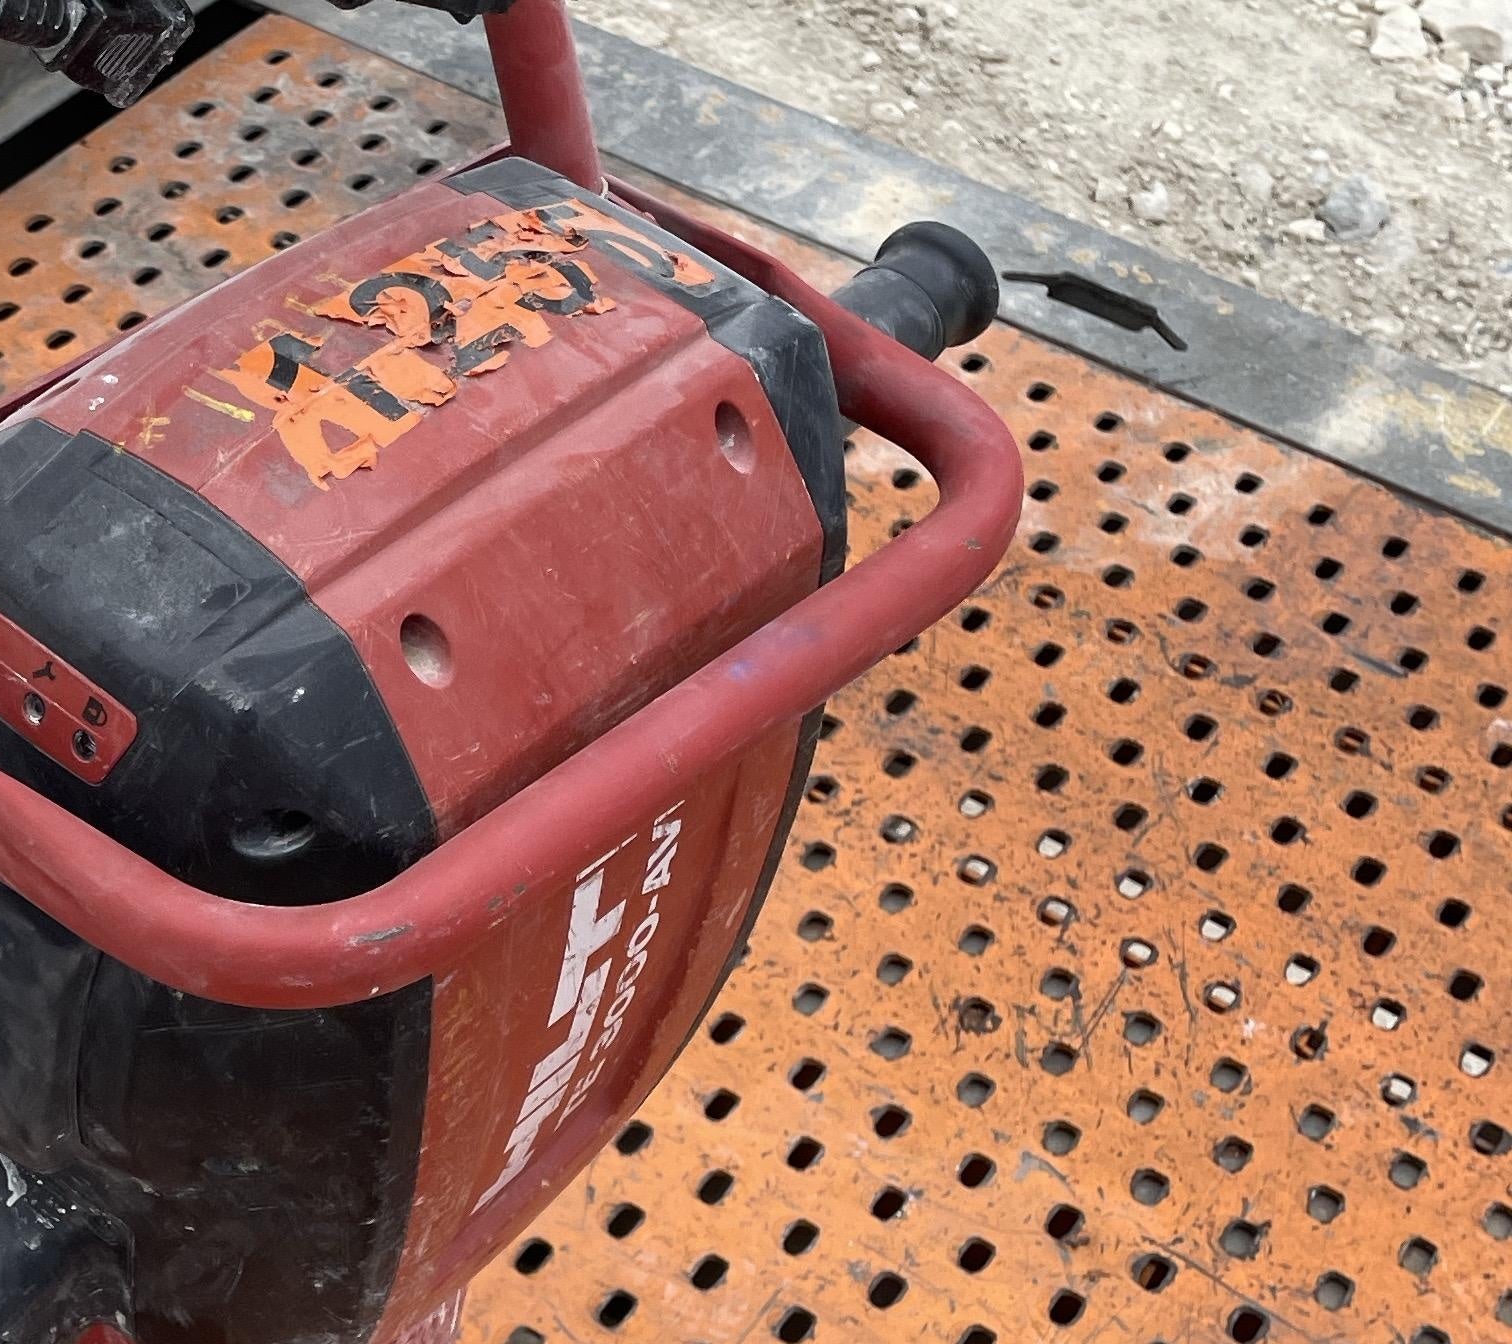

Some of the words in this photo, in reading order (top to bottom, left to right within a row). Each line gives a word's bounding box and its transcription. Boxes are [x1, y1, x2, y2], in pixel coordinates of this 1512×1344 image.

[469, 832, 638, 1215] HILT
[555, 1059, 605, 1133] TE
[590, 799, 686, 1061] 3000-AV
